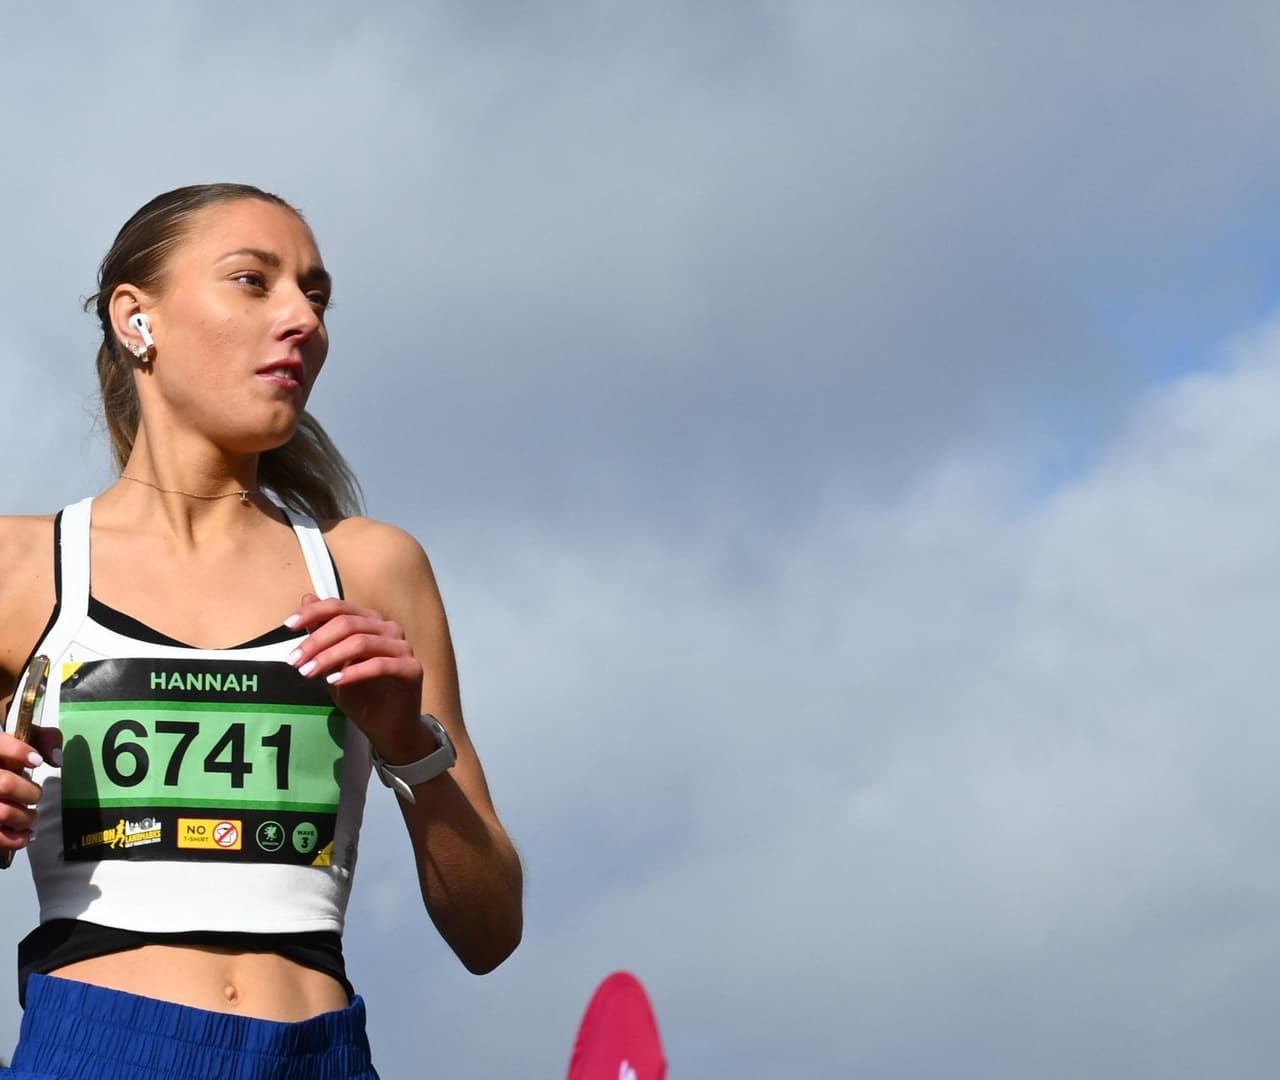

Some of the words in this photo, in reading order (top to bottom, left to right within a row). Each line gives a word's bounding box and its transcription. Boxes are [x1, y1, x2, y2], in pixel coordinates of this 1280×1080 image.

[150, 671, 258, 693] HANNAH
[101, 718, 293, 790] 6741
[186, 825, 206, 835] NO
[301, 837, 309, 849] 3
